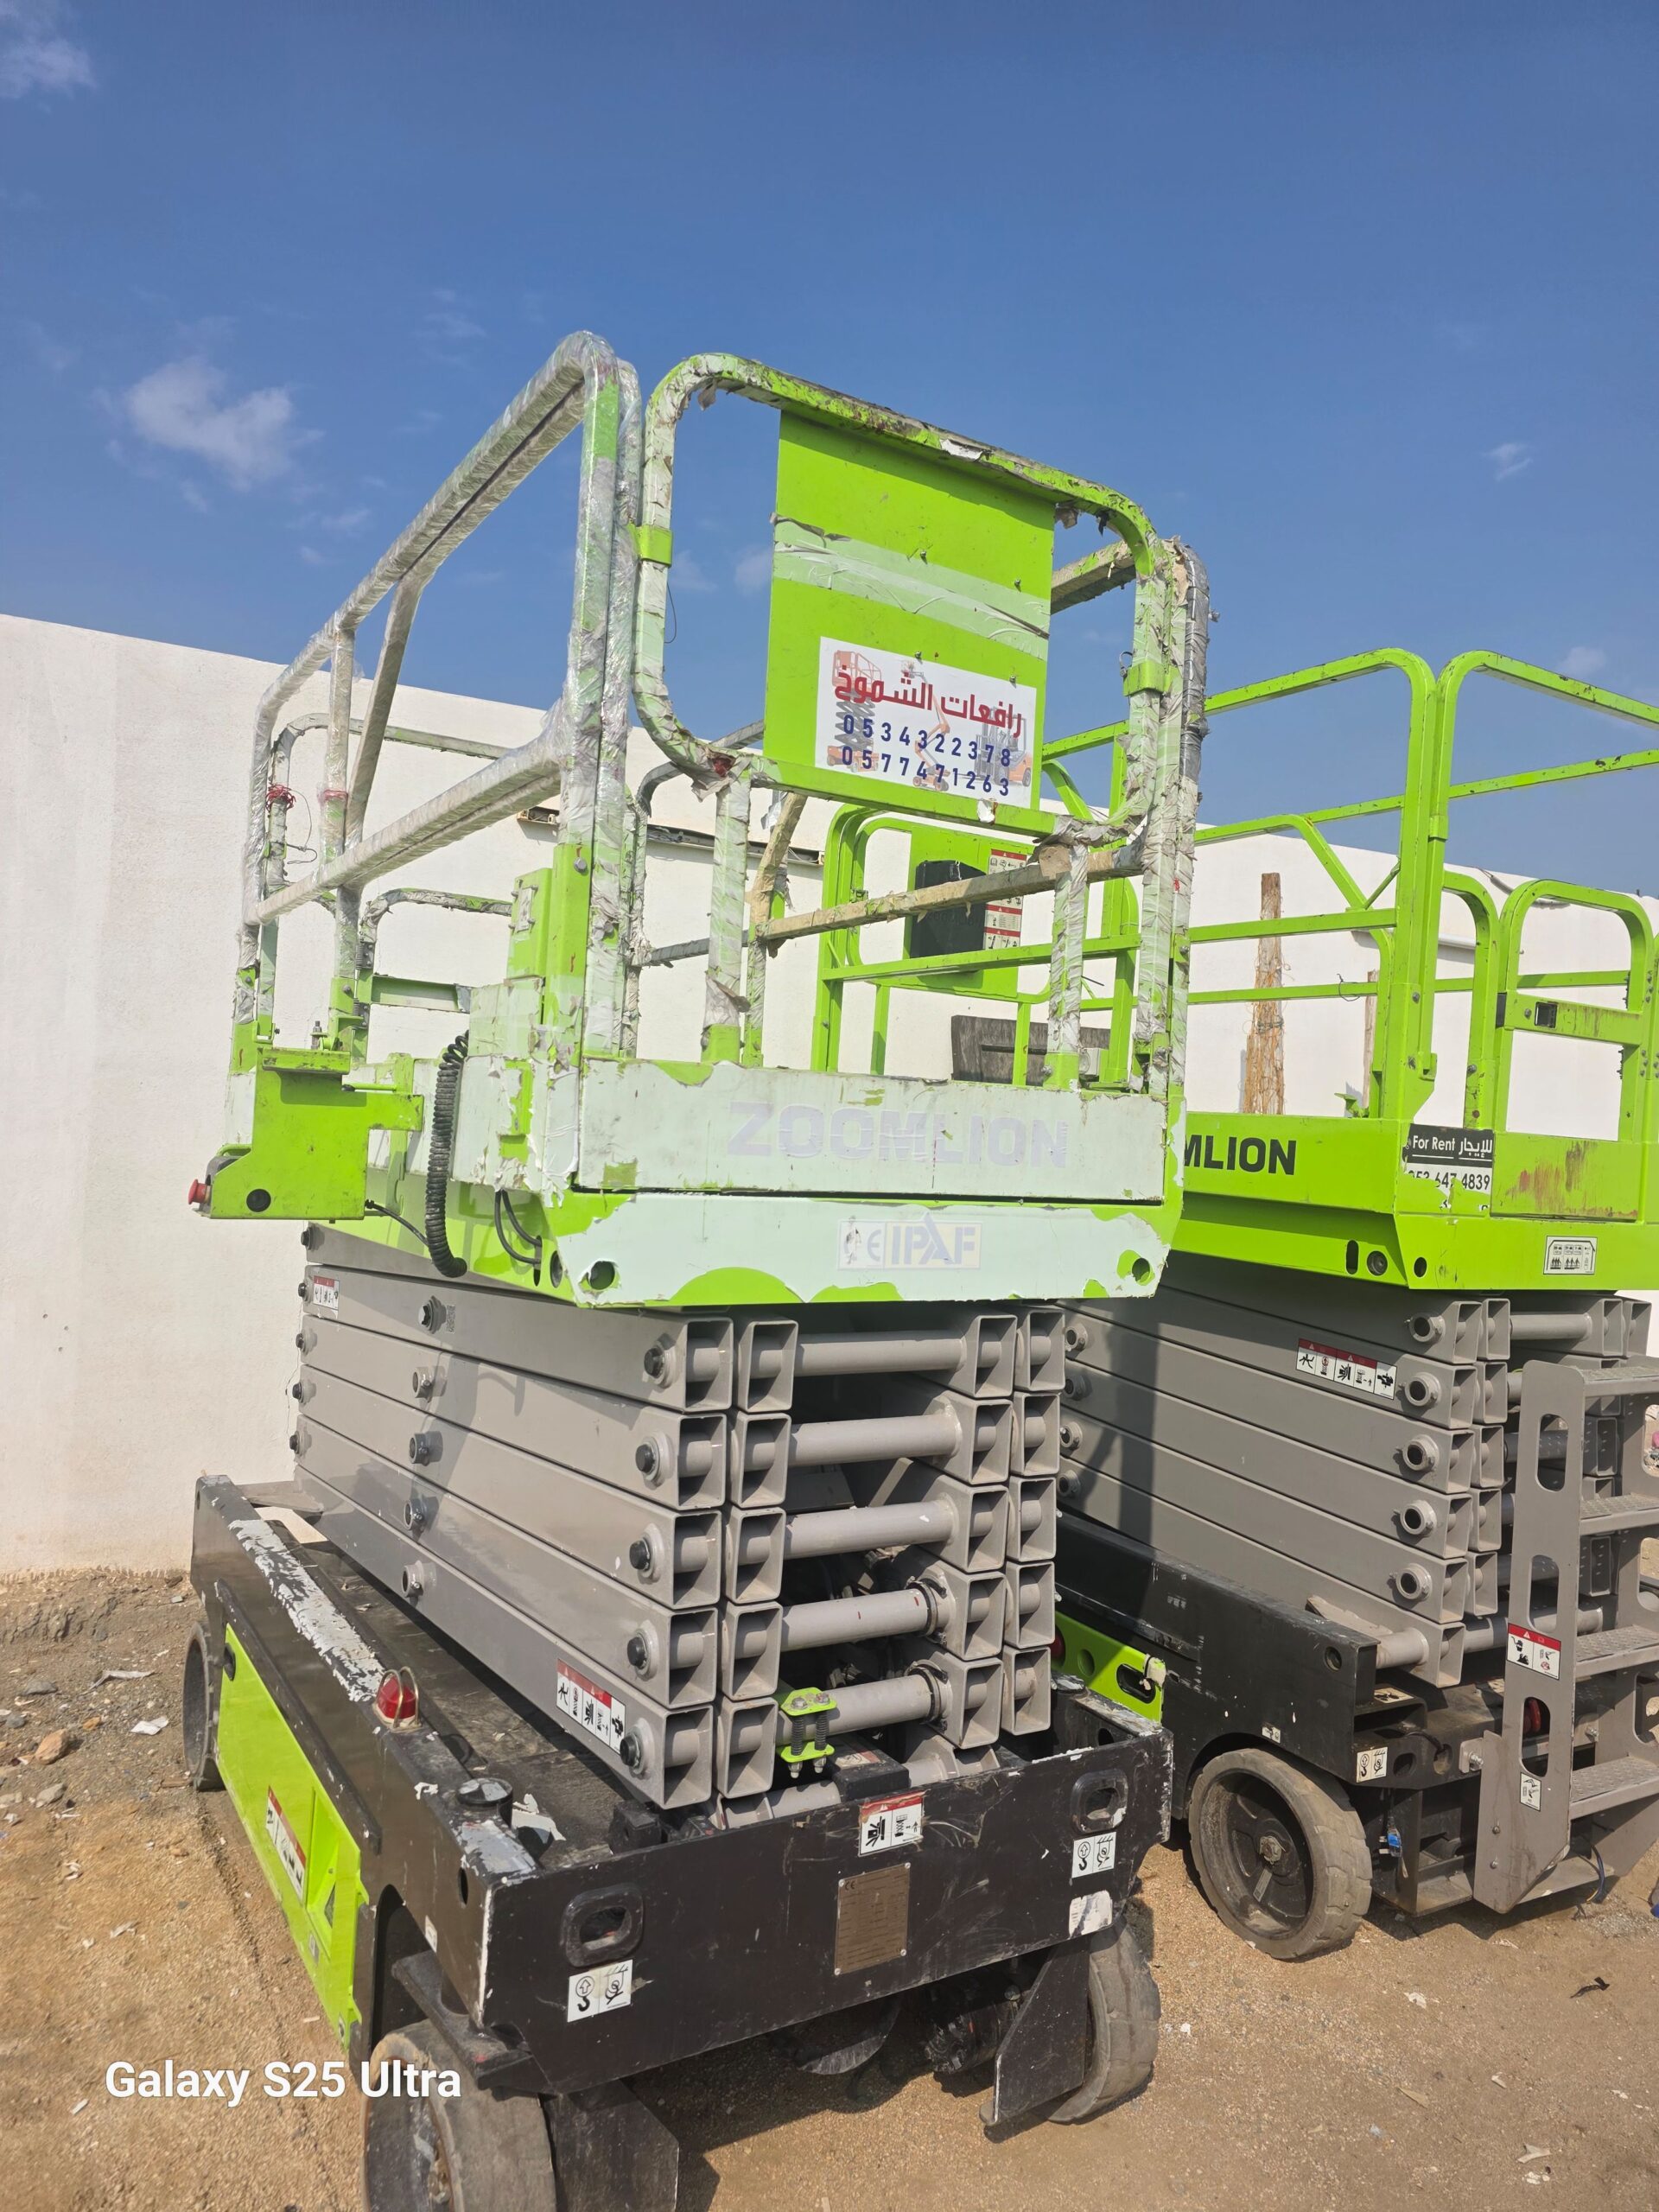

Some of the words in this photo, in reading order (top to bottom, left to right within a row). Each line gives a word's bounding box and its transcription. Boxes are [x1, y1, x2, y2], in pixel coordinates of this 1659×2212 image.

[834, 664, 933, 710] الشموخ
[940, 693, 1021, 738] رافعات
[843, 714, 1011, 767] 0534322378
[841, 746, 1009, 797] 0577471263
[727, 1101, 1068, 1168] ZOOMLION
[1413, 1135, 1429, 1151] For
[1432, 1137, 1455, 1151] Rent
[1461, 1173, 1491, 1190] 4839
[891, 1211, 976, 1265] IPAF
